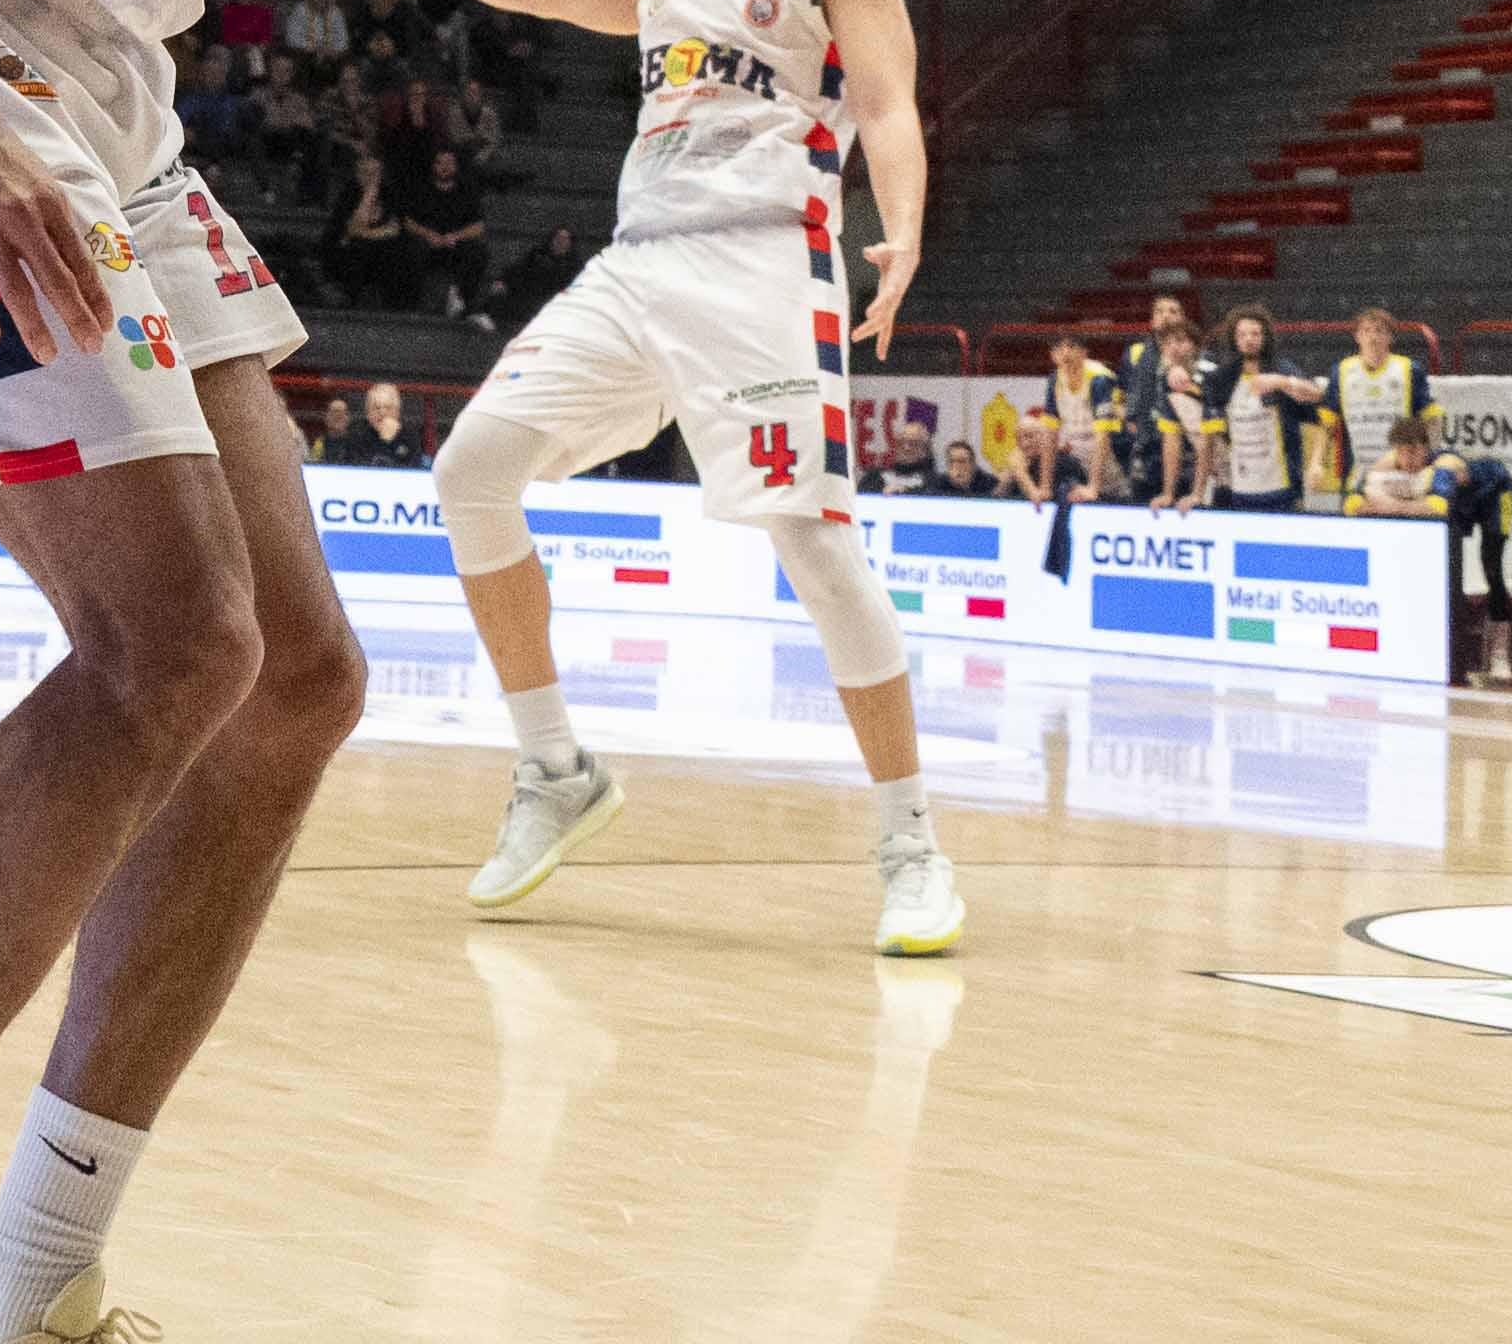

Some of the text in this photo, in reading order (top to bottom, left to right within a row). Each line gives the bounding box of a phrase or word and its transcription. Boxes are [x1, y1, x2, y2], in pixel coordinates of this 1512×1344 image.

[186, 192, 277, 299] 1
[749, 422, 798, 488] 4
[573, 541, 672, 563] Solution
[1090, 531, 1216, 574] CO.MET
[884, 561, 1008, 591] Metal Solution
[1227, 586, 1380, 619] Metal Solution
